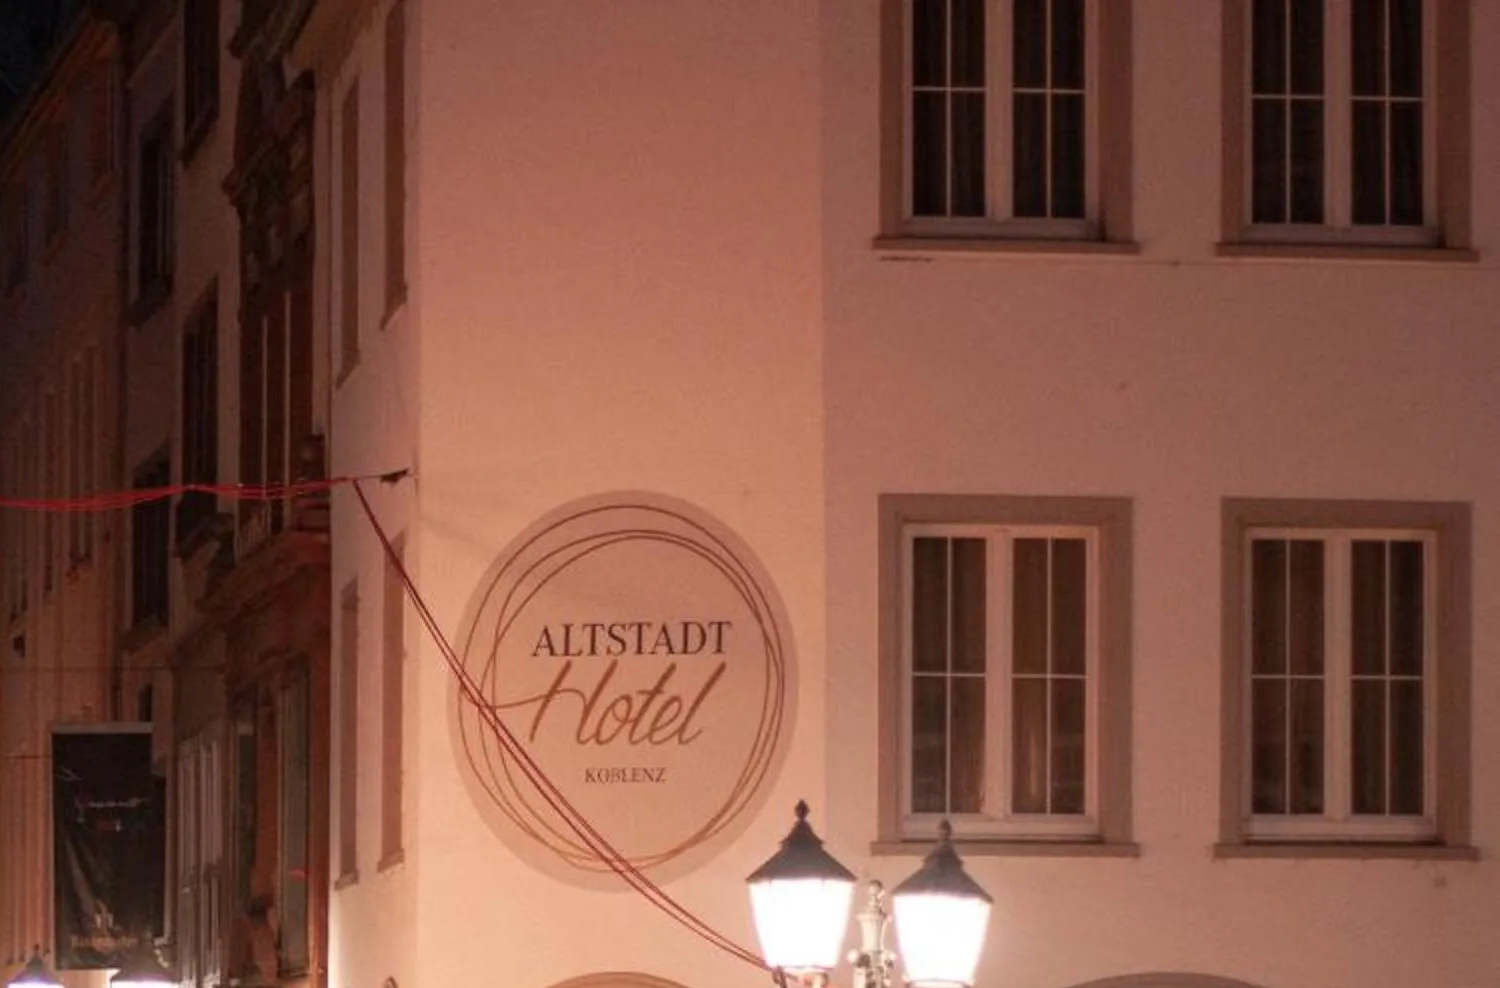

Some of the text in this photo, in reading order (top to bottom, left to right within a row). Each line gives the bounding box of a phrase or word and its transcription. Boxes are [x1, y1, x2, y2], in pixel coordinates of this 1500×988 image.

[531, 620, 733, 657] ALTSTADT
[526, 658, 726, 745] Hotel
[584, 766, 668, 784] KOBLENZ
